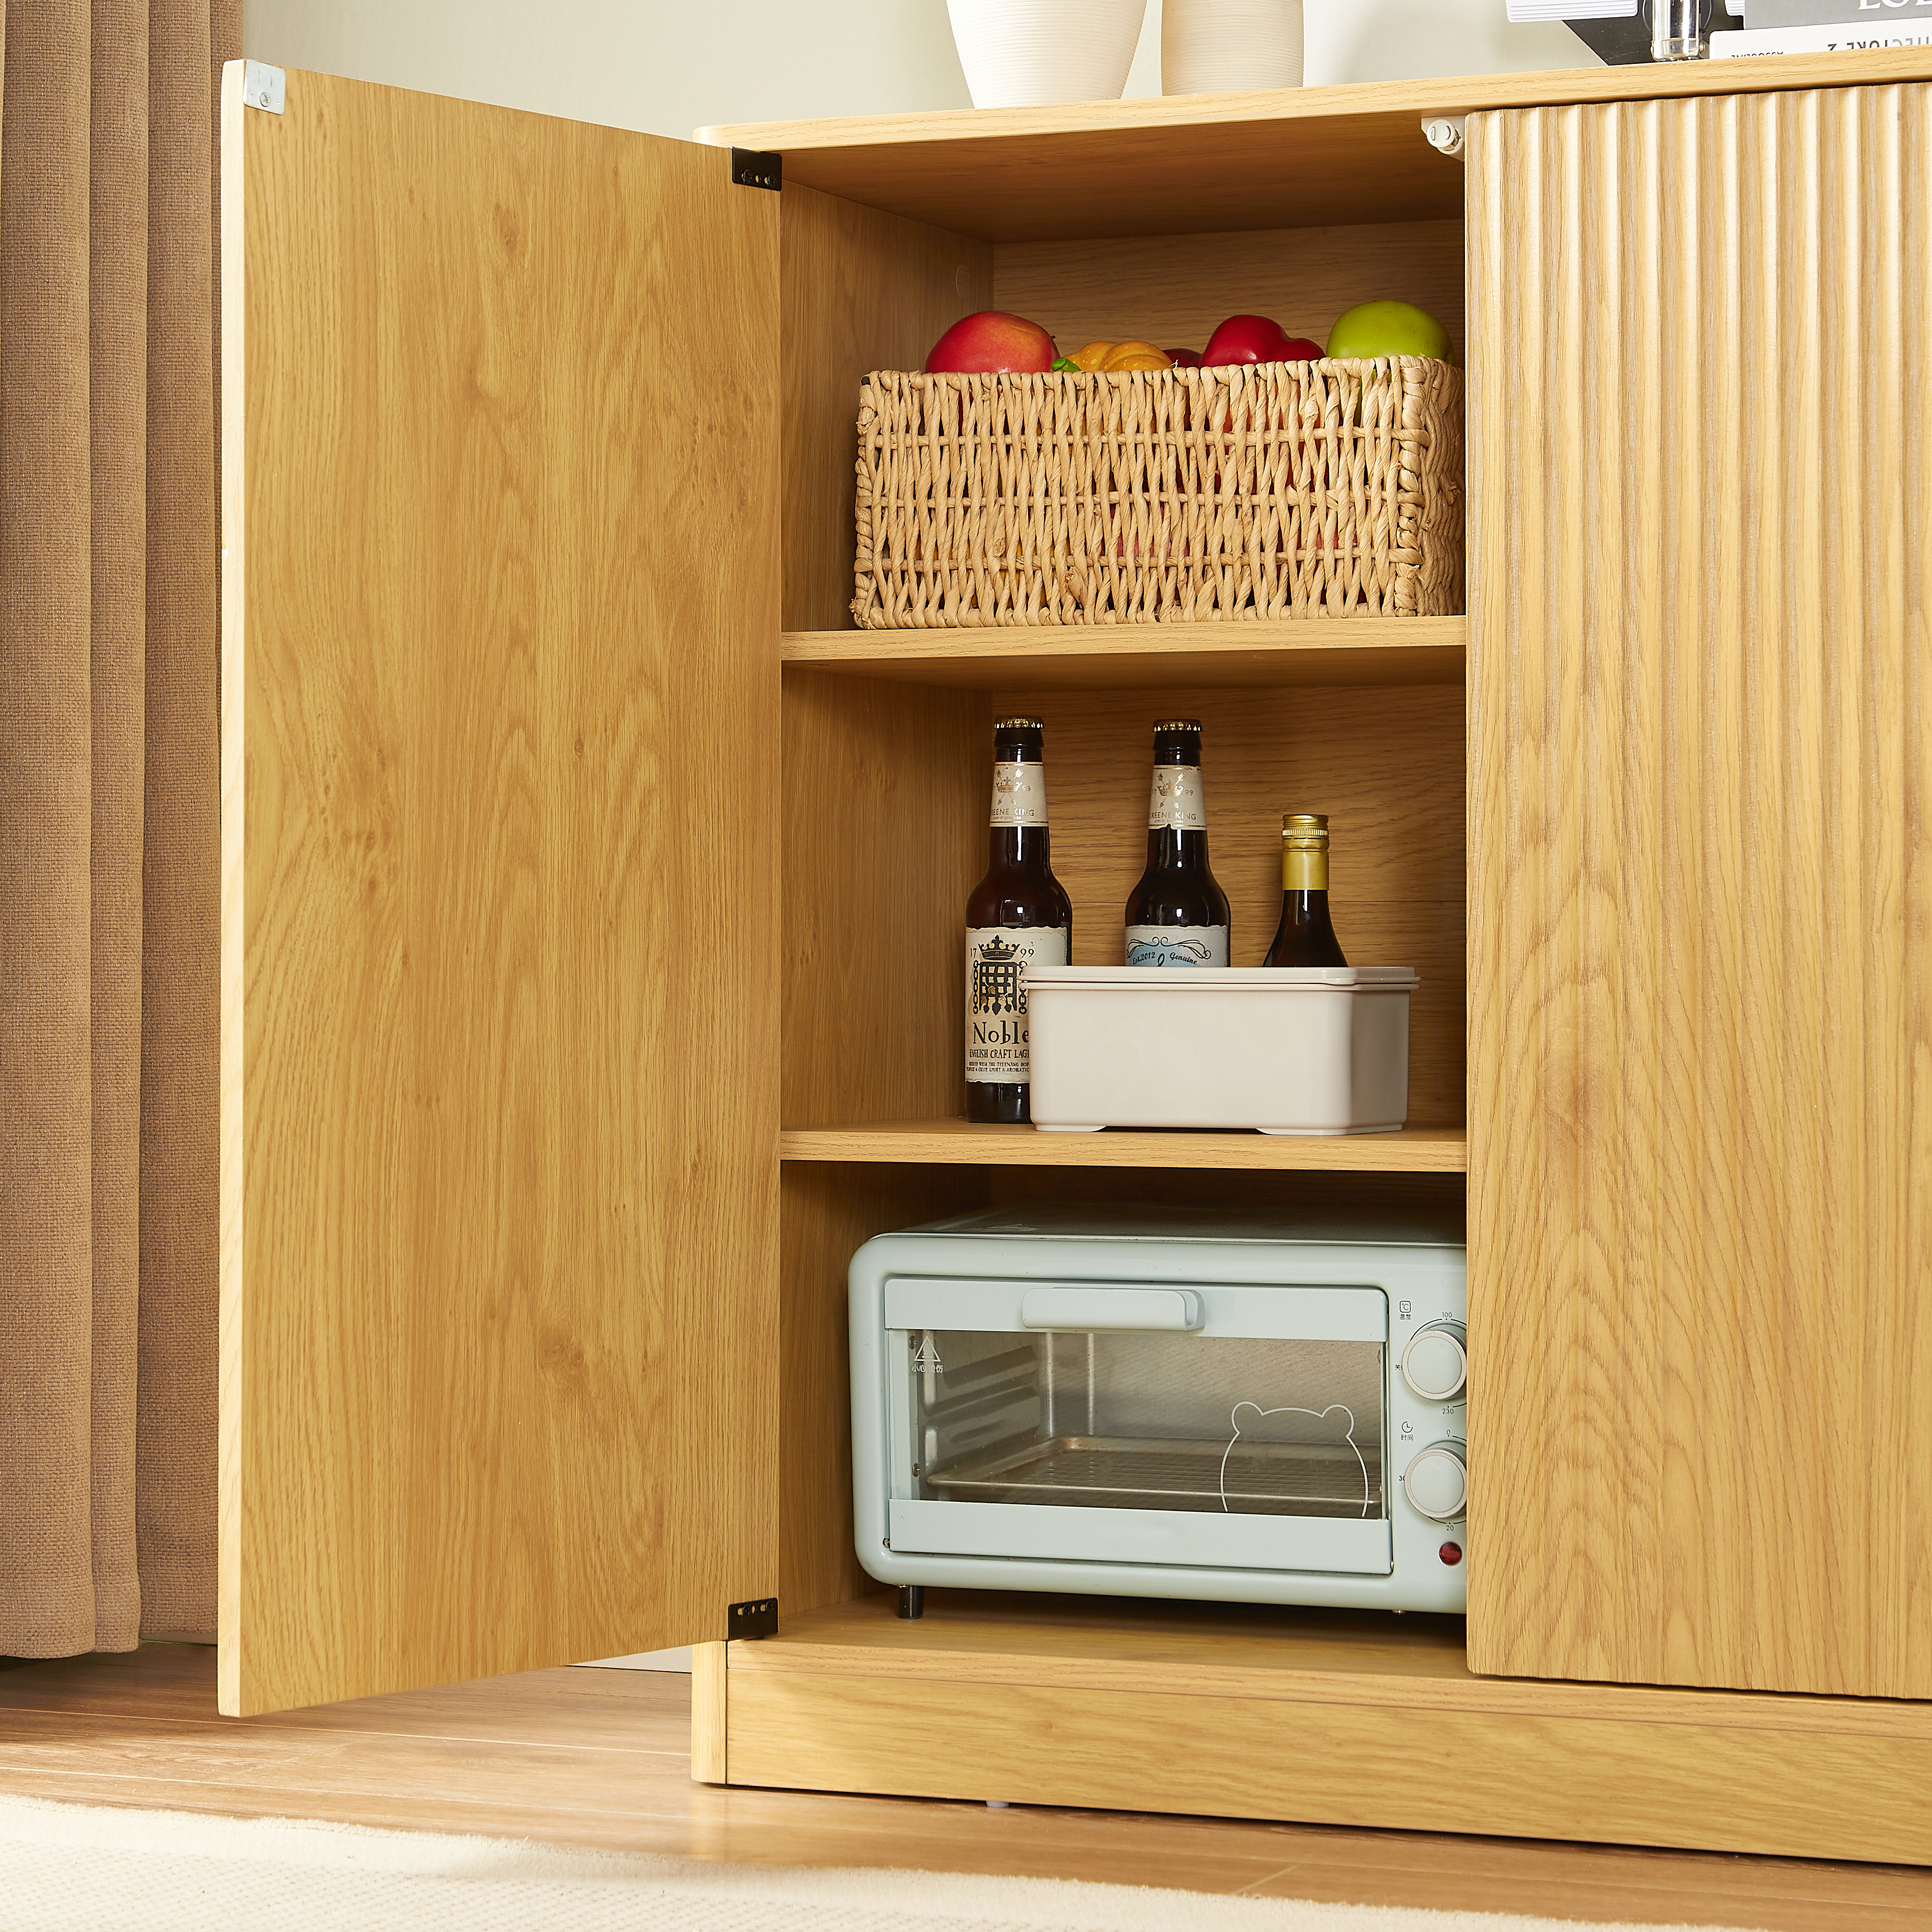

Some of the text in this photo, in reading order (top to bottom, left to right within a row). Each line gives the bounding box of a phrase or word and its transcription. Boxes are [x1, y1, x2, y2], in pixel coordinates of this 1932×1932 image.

[1014, 808, 1035, 816] KING
[1175, 812, 1197, 820] KING
[969, 947, 1035, 958] 17 99
[1169, 952, 1197, 965] Genuine
[972, 1020, 1029, 1045] Noble
[969, 1049, 988, 1058] ENGLISH
[990, 1049, 1012, 1059] CRAFT
